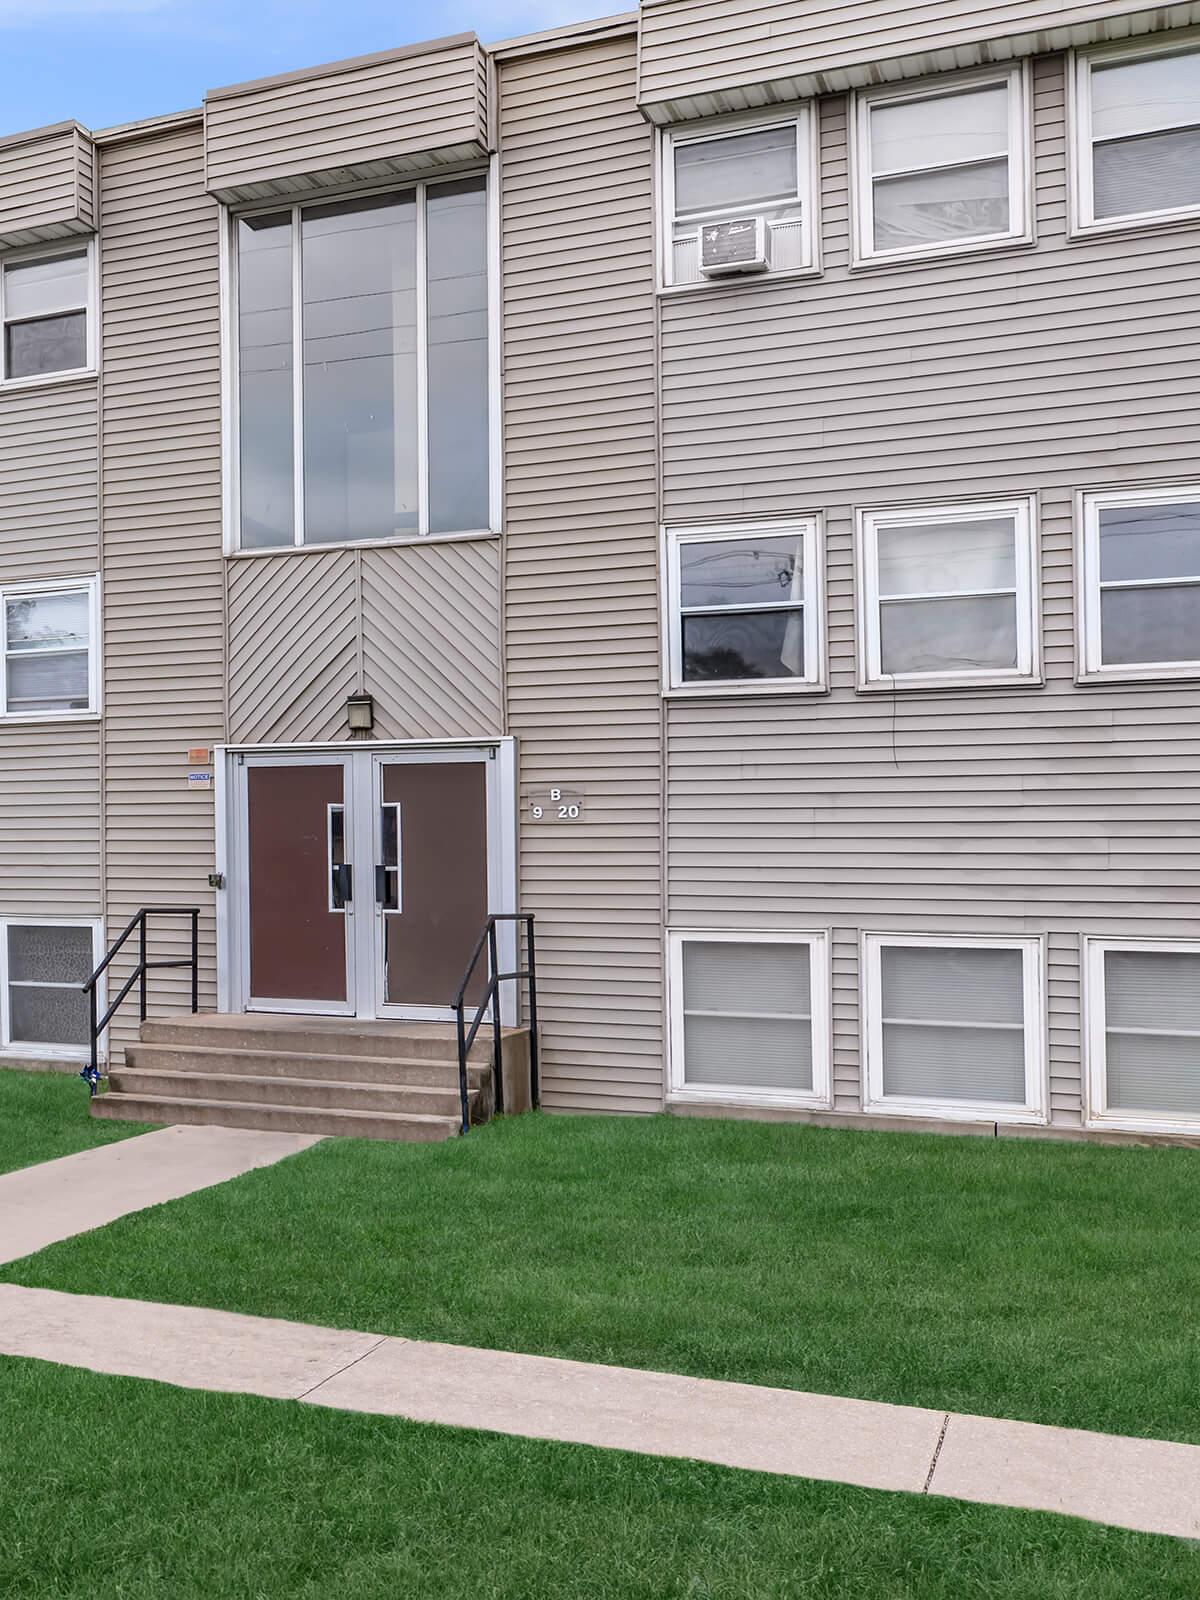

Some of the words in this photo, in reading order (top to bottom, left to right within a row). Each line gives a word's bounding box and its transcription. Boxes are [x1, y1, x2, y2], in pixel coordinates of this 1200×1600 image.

[550, 789, 561, 800] B
[533, 807, 542, 818] 9
[558, 806, 578, 818] 20
